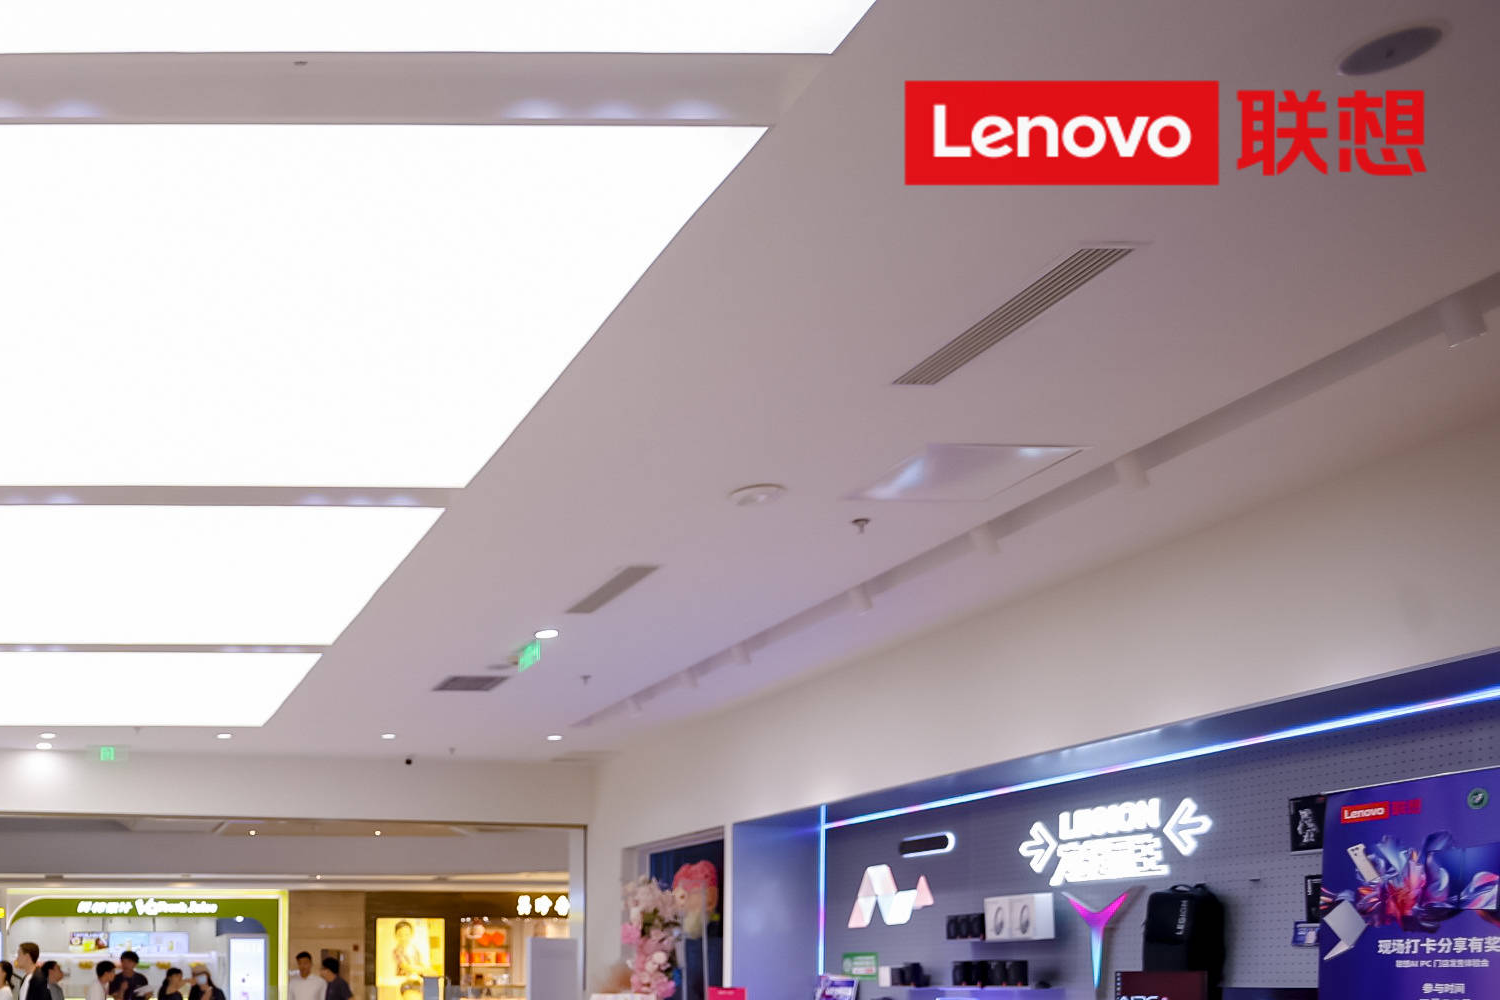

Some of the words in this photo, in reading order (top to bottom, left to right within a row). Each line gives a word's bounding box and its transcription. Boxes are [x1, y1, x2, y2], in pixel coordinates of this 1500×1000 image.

[1344, 807, 1385, 820] Lenovo
[1175, 900, 1189, 935] LEGION
[1377, 936, 1500, 955] 现场打卡分享有奖
